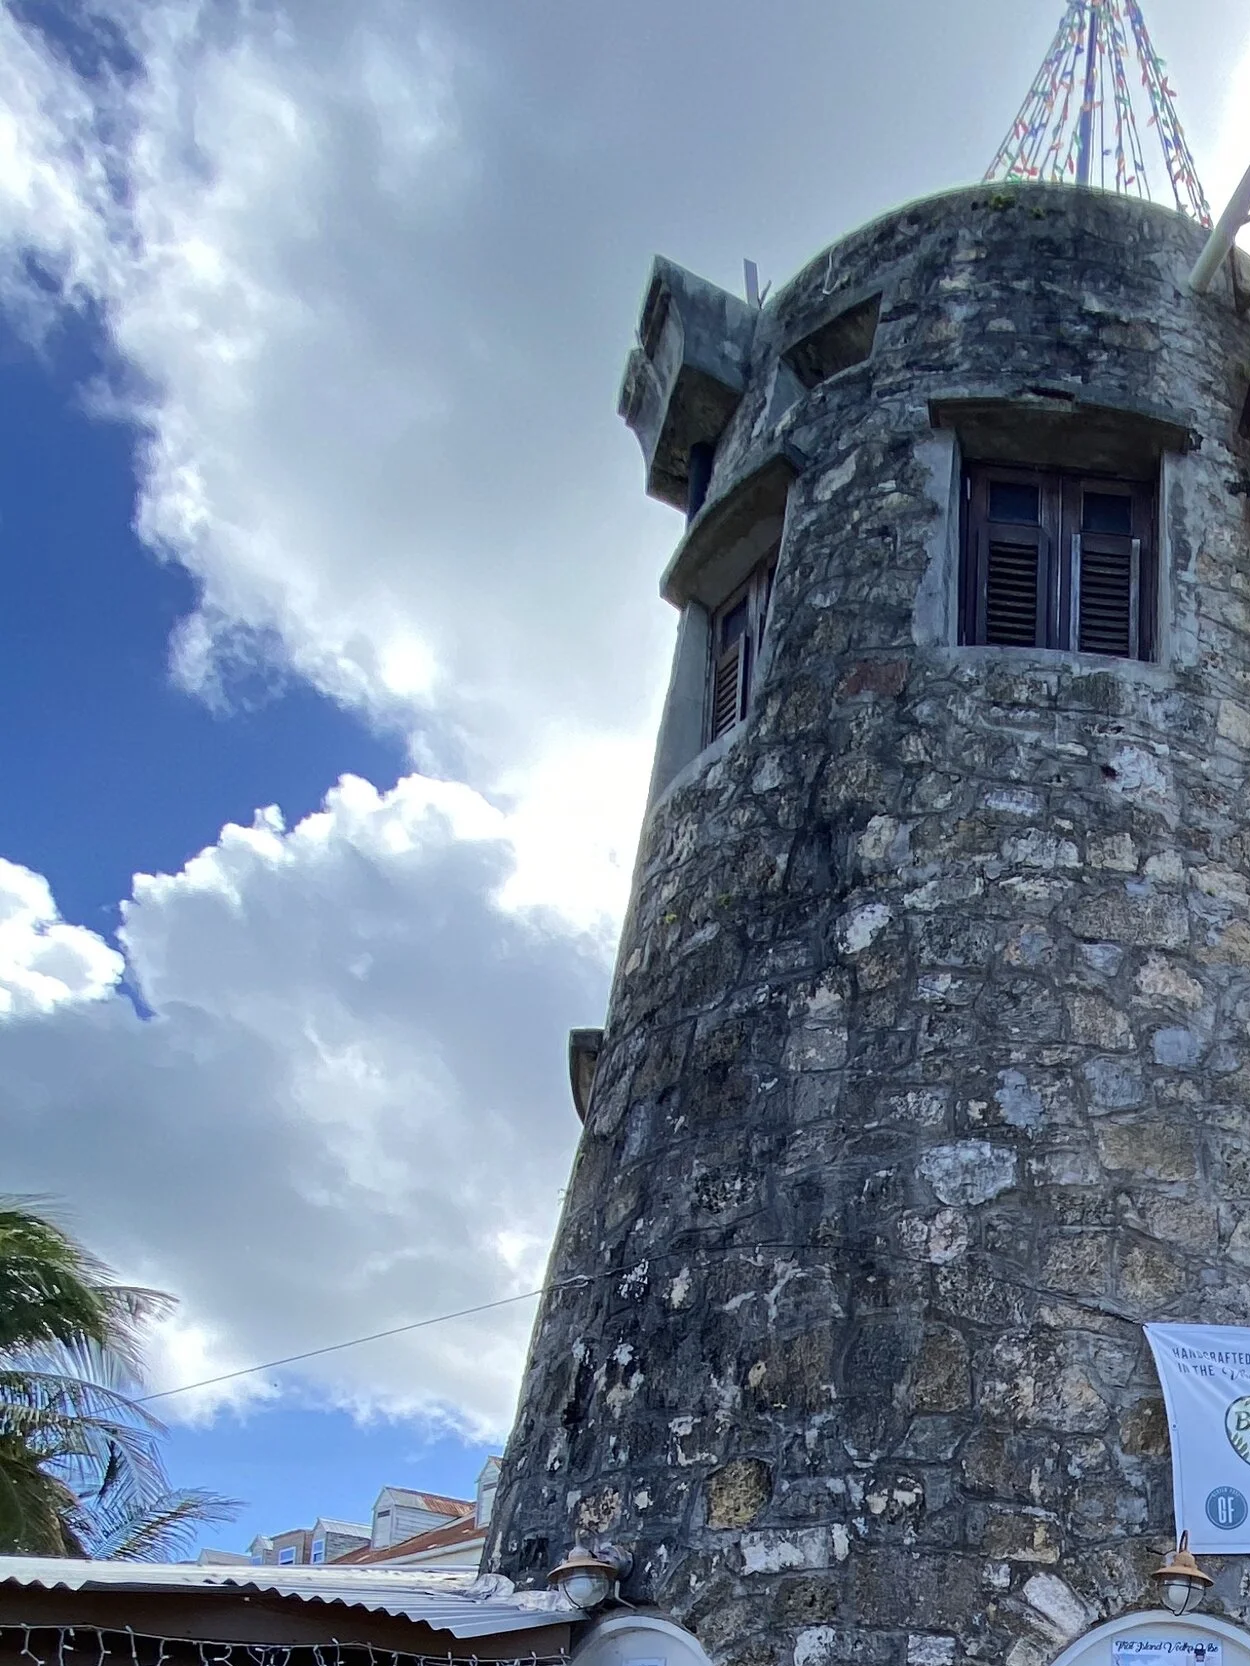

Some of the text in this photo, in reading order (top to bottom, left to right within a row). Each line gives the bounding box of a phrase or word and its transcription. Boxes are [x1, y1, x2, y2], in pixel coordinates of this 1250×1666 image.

[1172, 1348, 1250, 1365] HANDCRAFTED
[1178, 1363, 1190, 1373] IN
[1194, 1365, 1215, 1377] THE
[1217, 1496, 1235, 1524] GF
